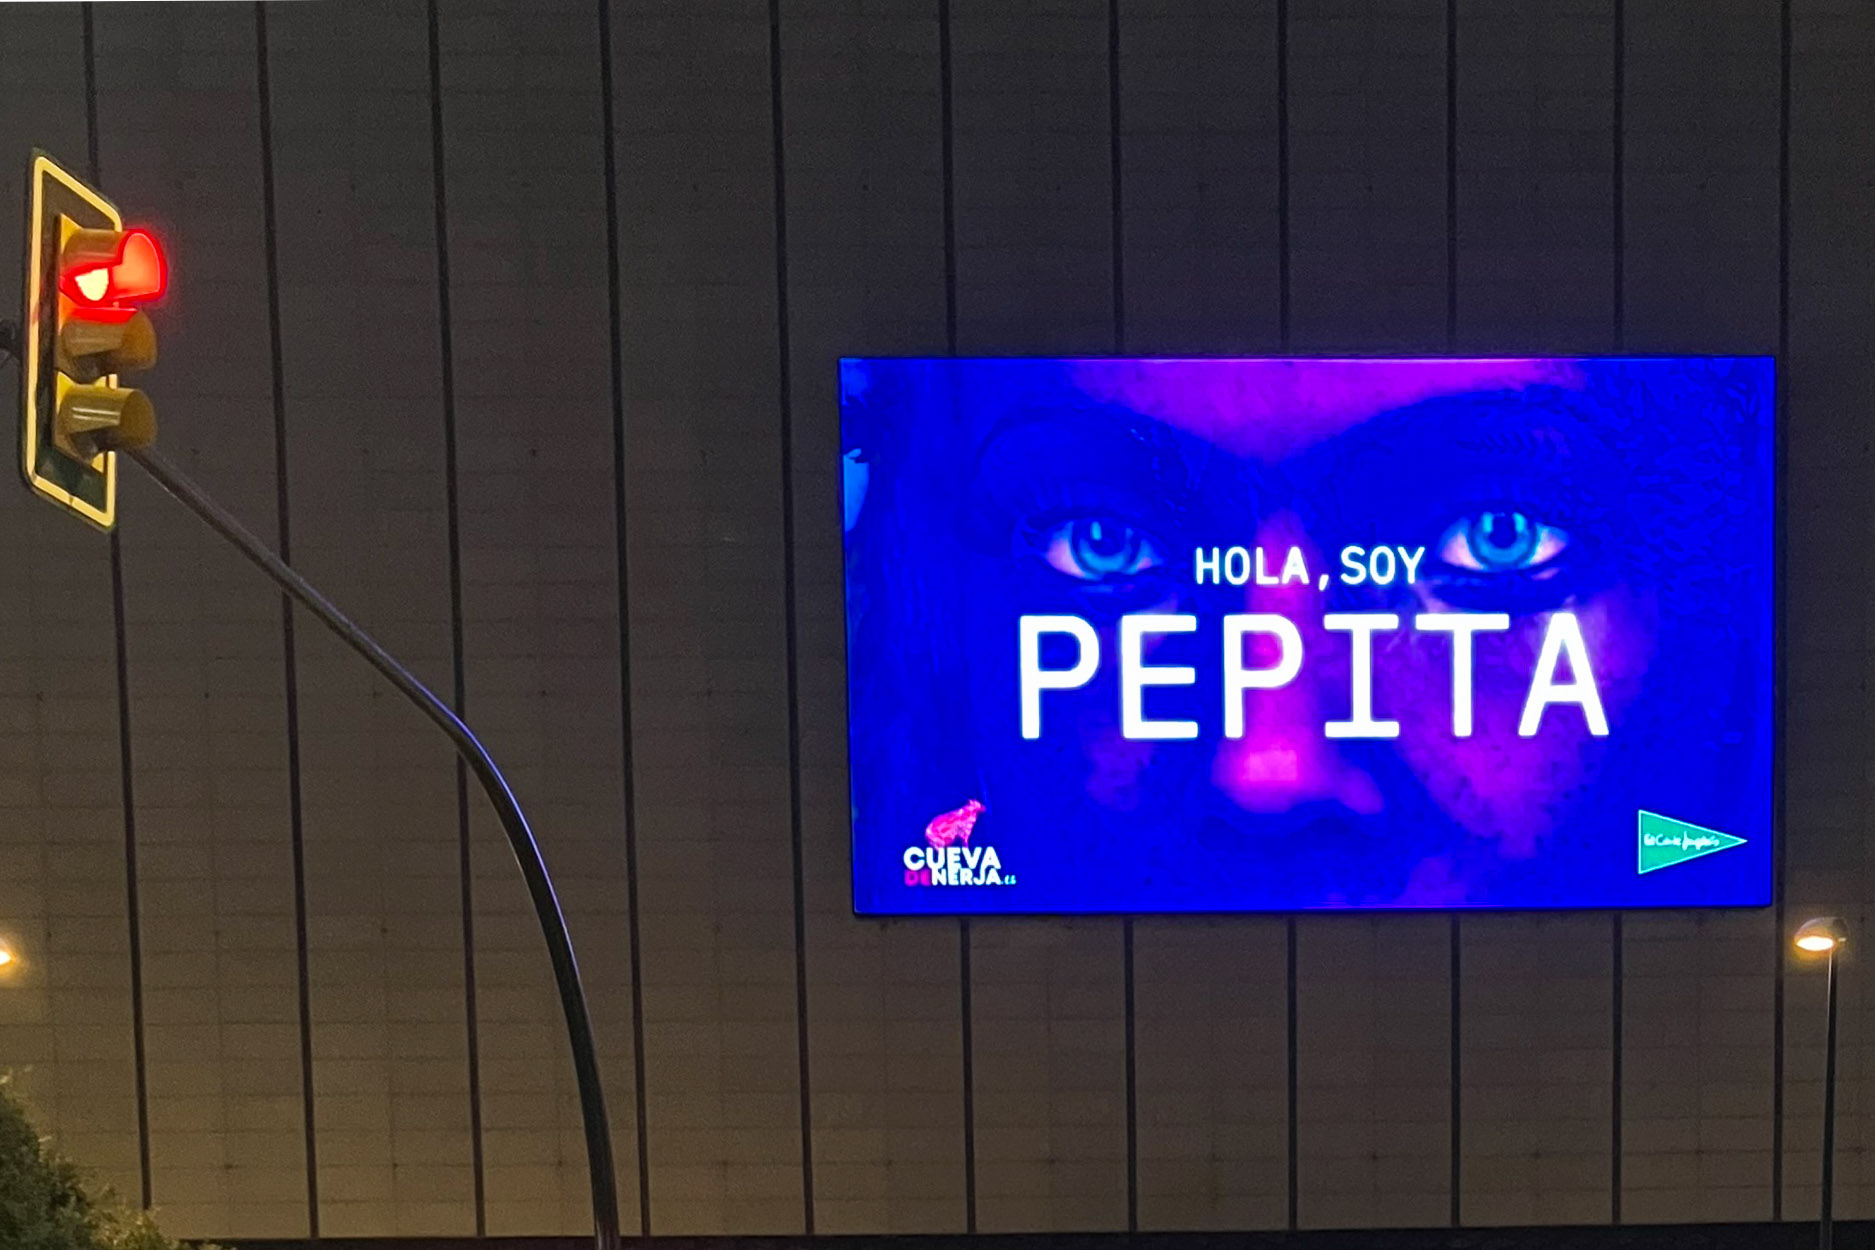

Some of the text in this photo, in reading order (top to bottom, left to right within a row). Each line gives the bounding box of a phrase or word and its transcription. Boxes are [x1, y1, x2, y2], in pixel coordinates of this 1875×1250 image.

[1195, 545, 1425, 591] HOLA, SOY
[1019, 613, 1610, 740] PEPITA
[903, 846, 1001, 871] CUEVA
